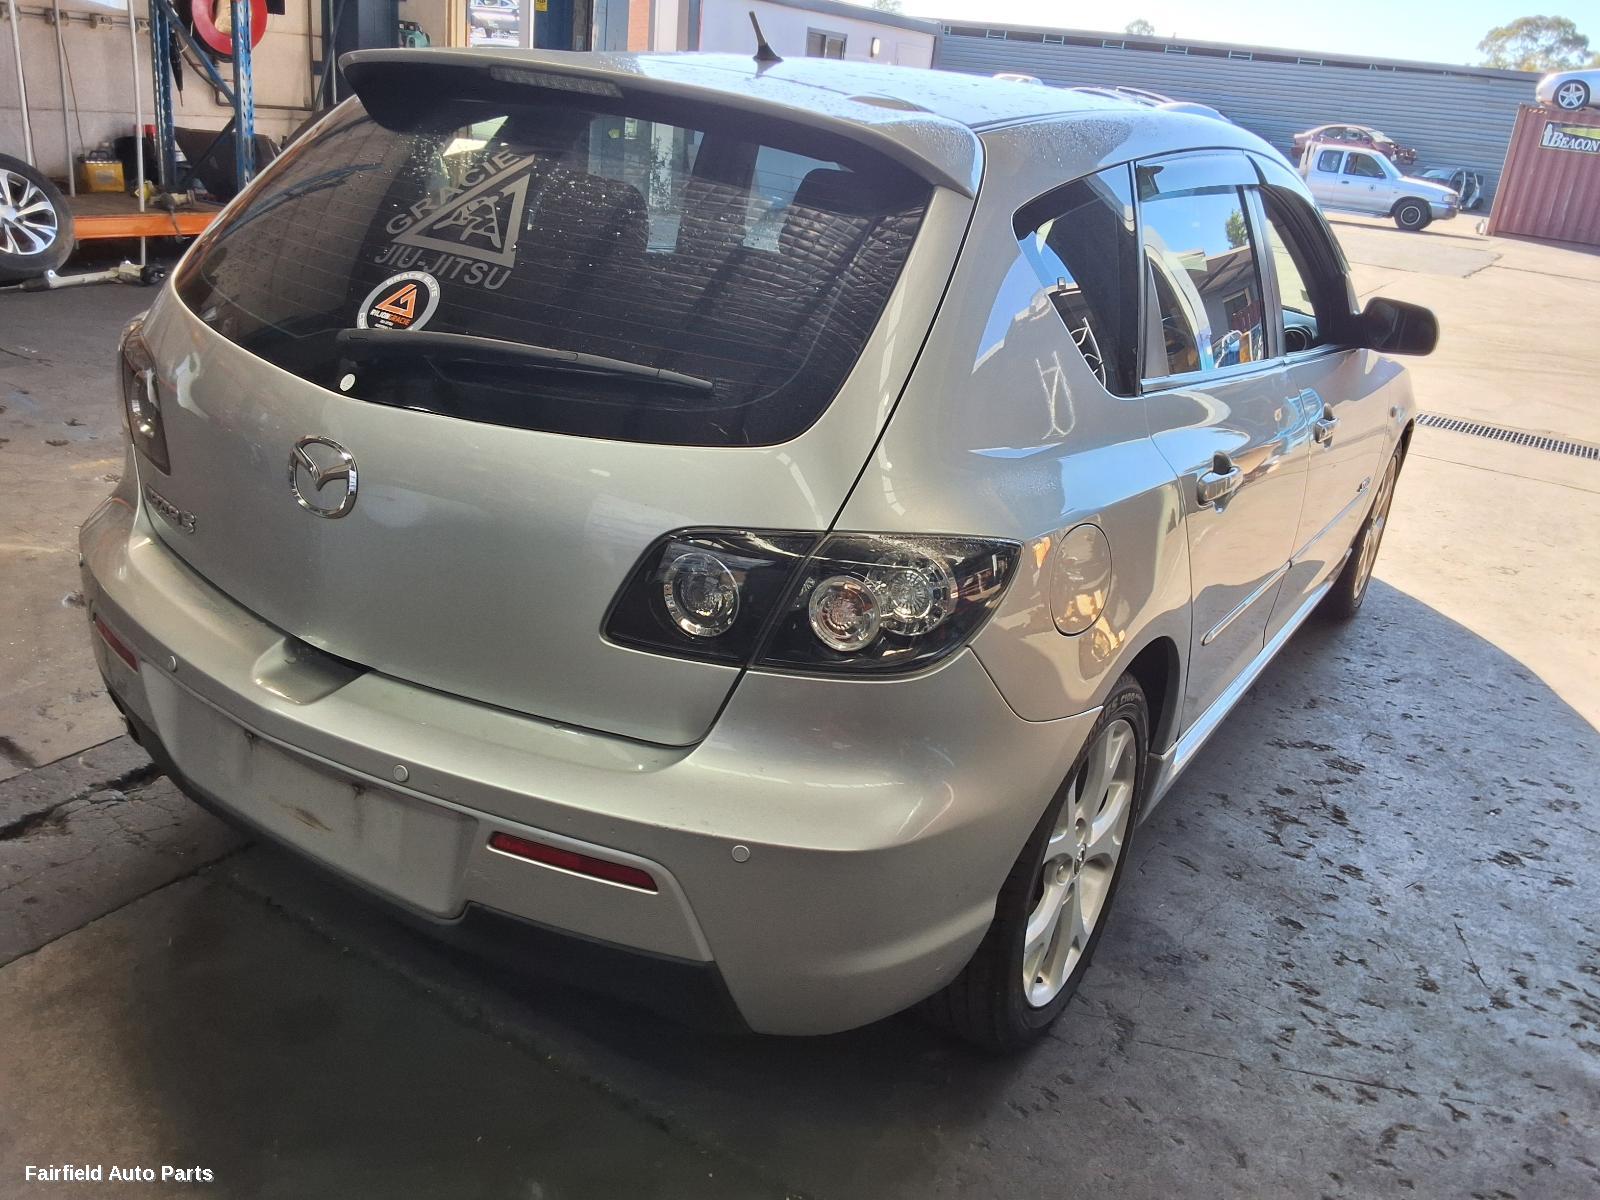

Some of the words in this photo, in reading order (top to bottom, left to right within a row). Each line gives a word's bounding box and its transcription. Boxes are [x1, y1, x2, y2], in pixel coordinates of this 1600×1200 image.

[1549, 132, 1600, 152] BEACON
[386, 150, 519, 234] GRACIE
[374, 245, 511, 290] JIU-JITSU
